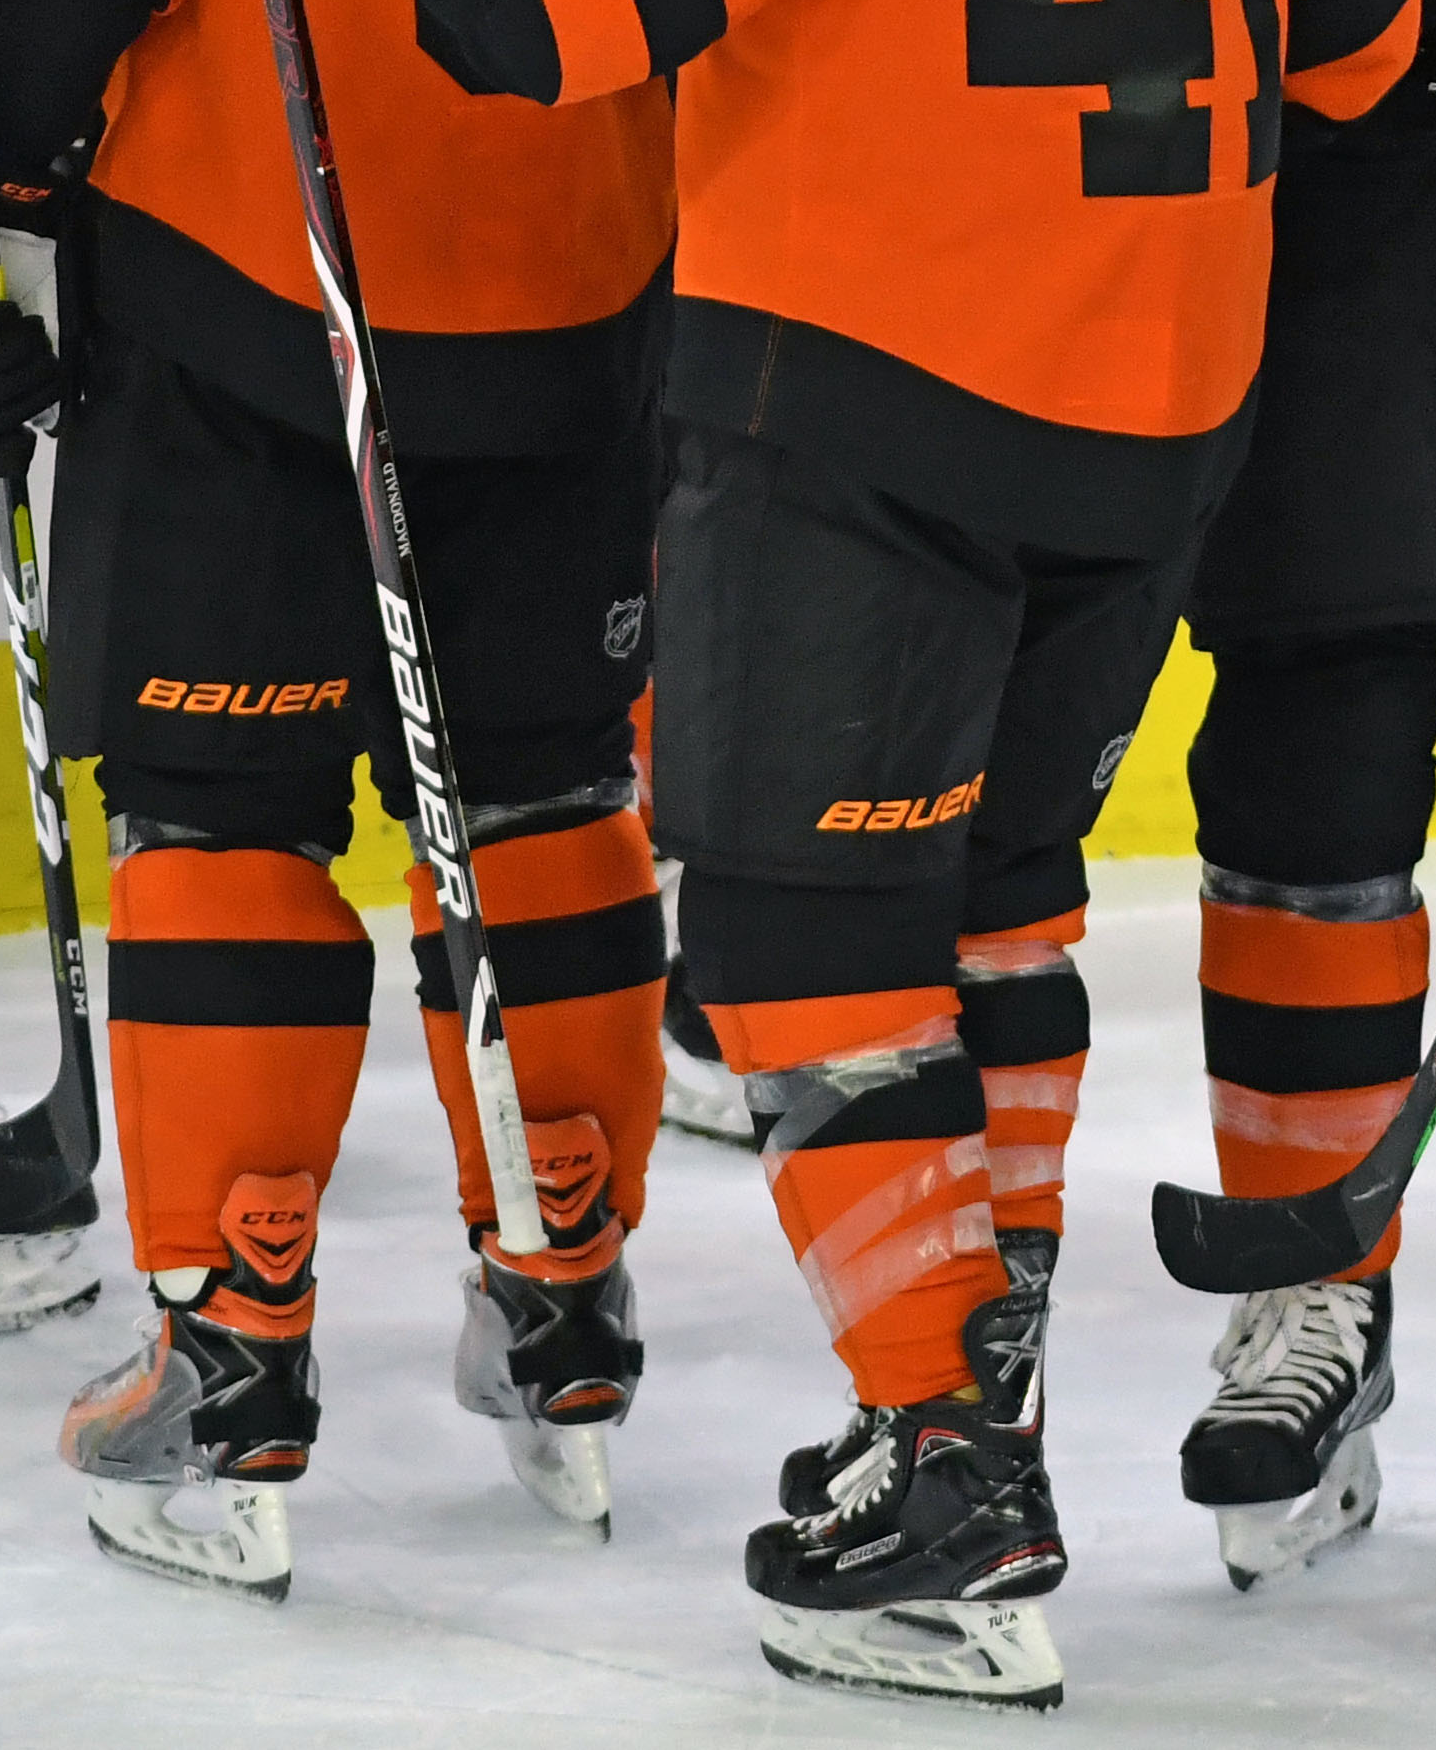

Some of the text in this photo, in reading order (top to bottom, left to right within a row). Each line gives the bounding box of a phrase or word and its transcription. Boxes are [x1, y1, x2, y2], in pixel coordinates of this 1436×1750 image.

[381, 461, 412, 558] MACDONALD
[137, 677, 351, 715] BAUER
[375, 581, 472, 919] BAUER
[816, 772, 983, 830] BAUER
[65, 938, 88, 1016] CCM
[240, 1210, 306, 1225] CCM
